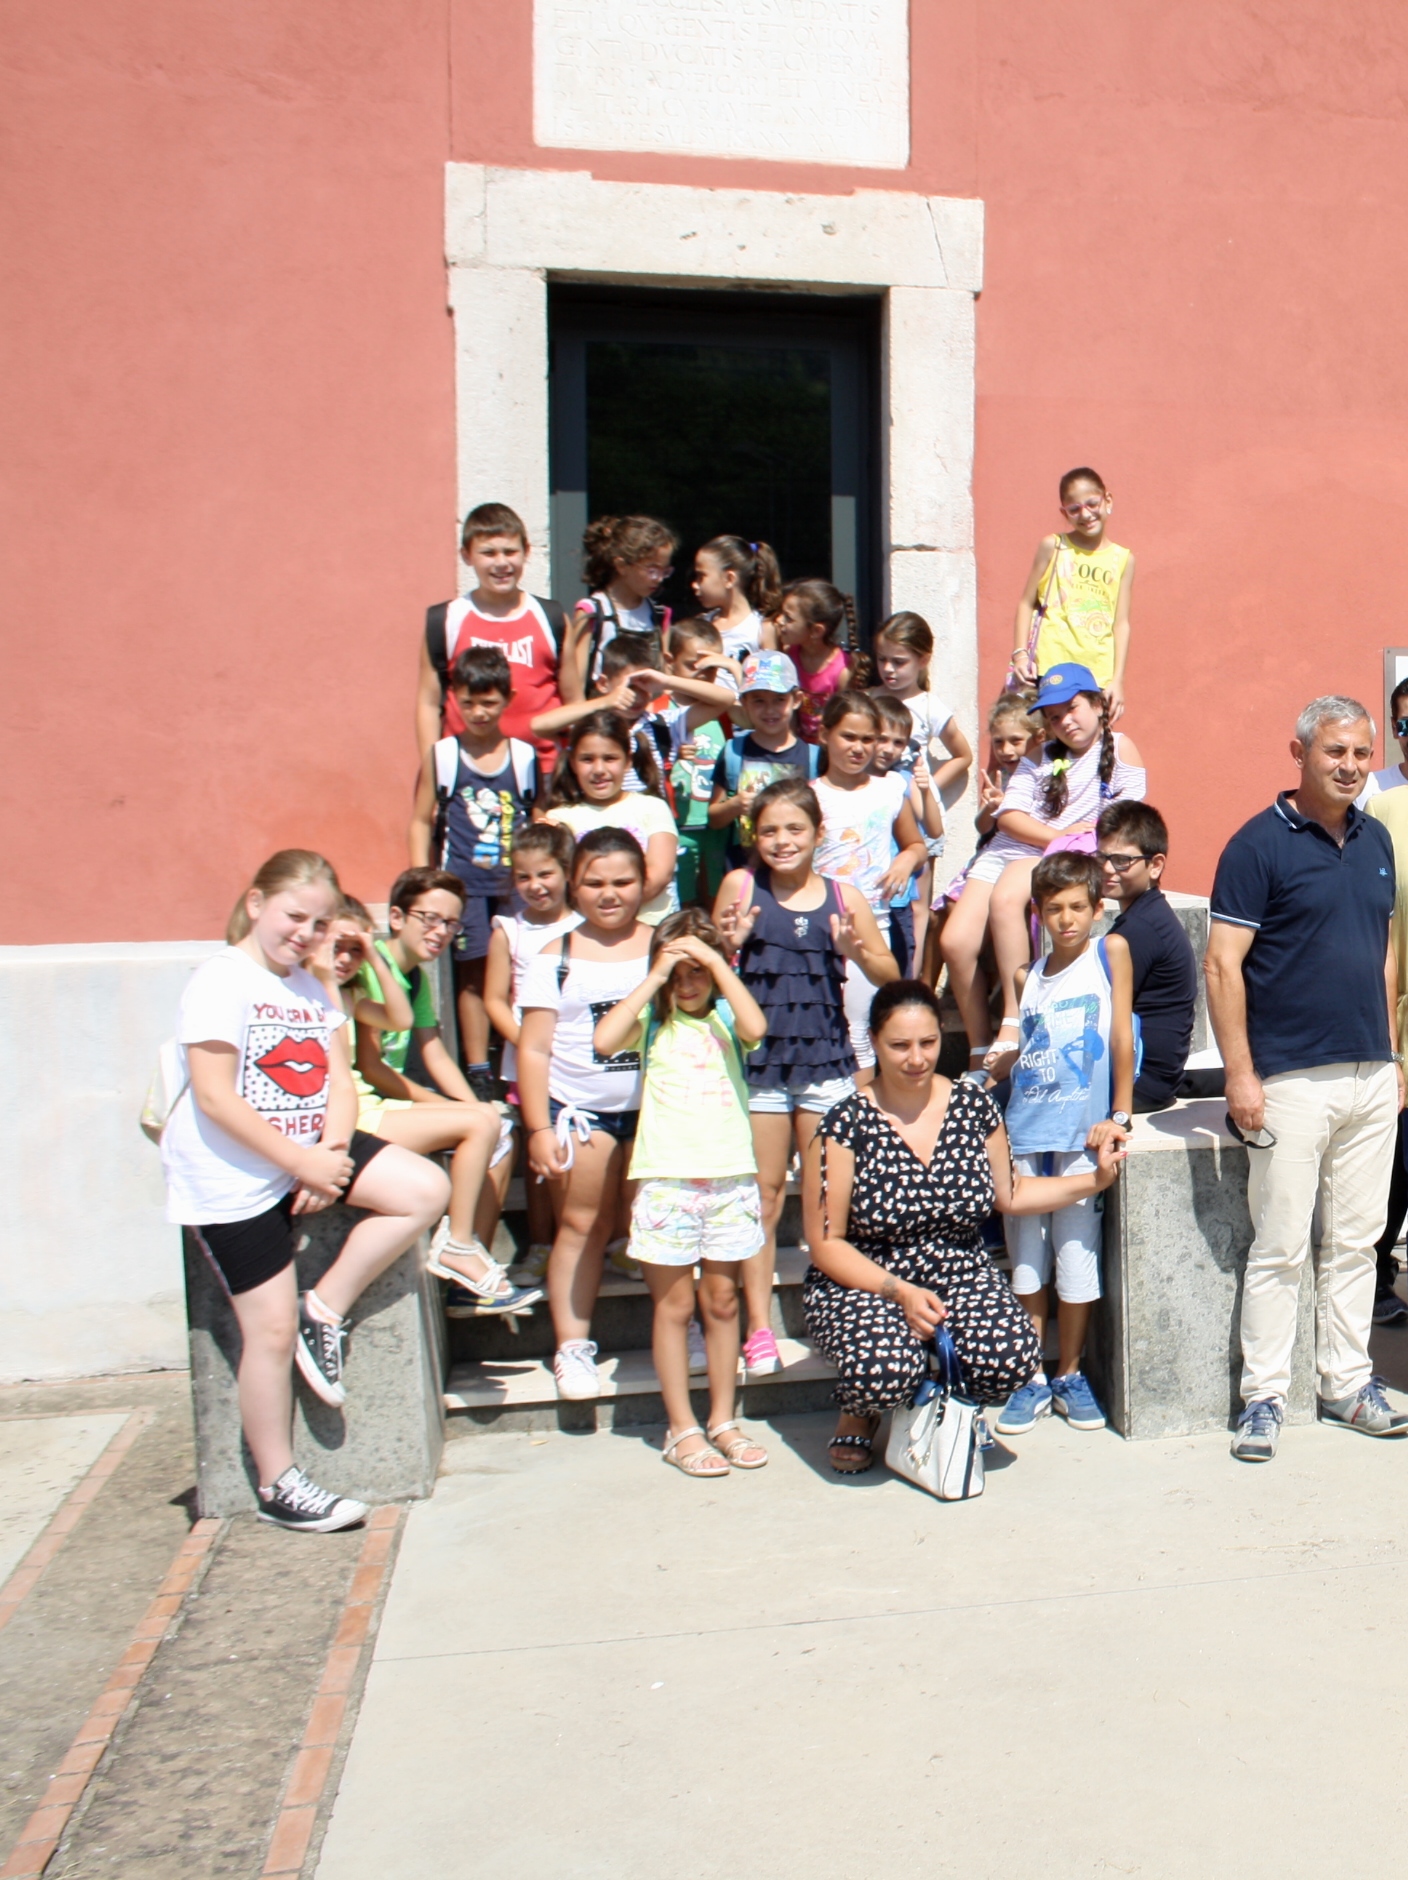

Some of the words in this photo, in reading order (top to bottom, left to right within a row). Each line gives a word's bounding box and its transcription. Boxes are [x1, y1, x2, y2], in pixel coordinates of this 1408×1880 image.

[470, 636, 534, 668] LAST
[1020, 1049, 1057, 1070] RIGHT
[1038, 1066, 1056, 1083] TO
